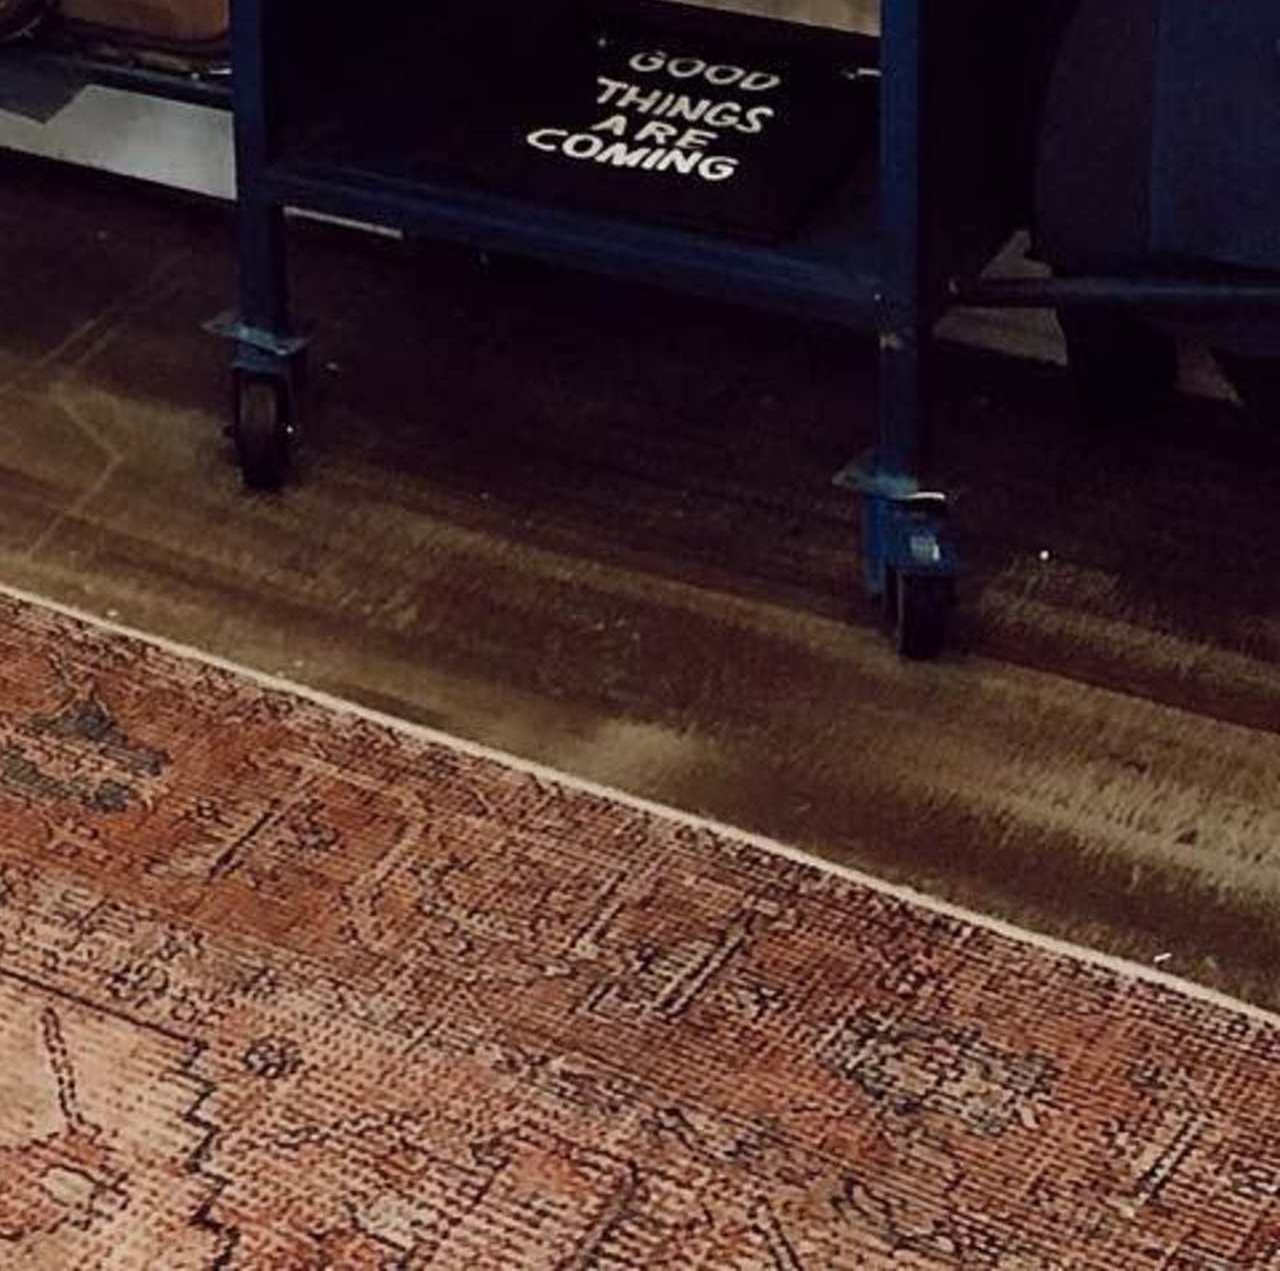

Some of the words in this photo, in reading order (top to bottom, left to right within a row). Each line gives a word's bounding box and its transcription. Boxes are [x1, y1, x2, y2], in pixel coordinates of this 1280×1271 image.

[628, 49, 781, 91] GOOD
[596, 75, 775, 135] THINGS
[526, 128, 740, 182] COMING
[591, 114, 719, 150] ARE
